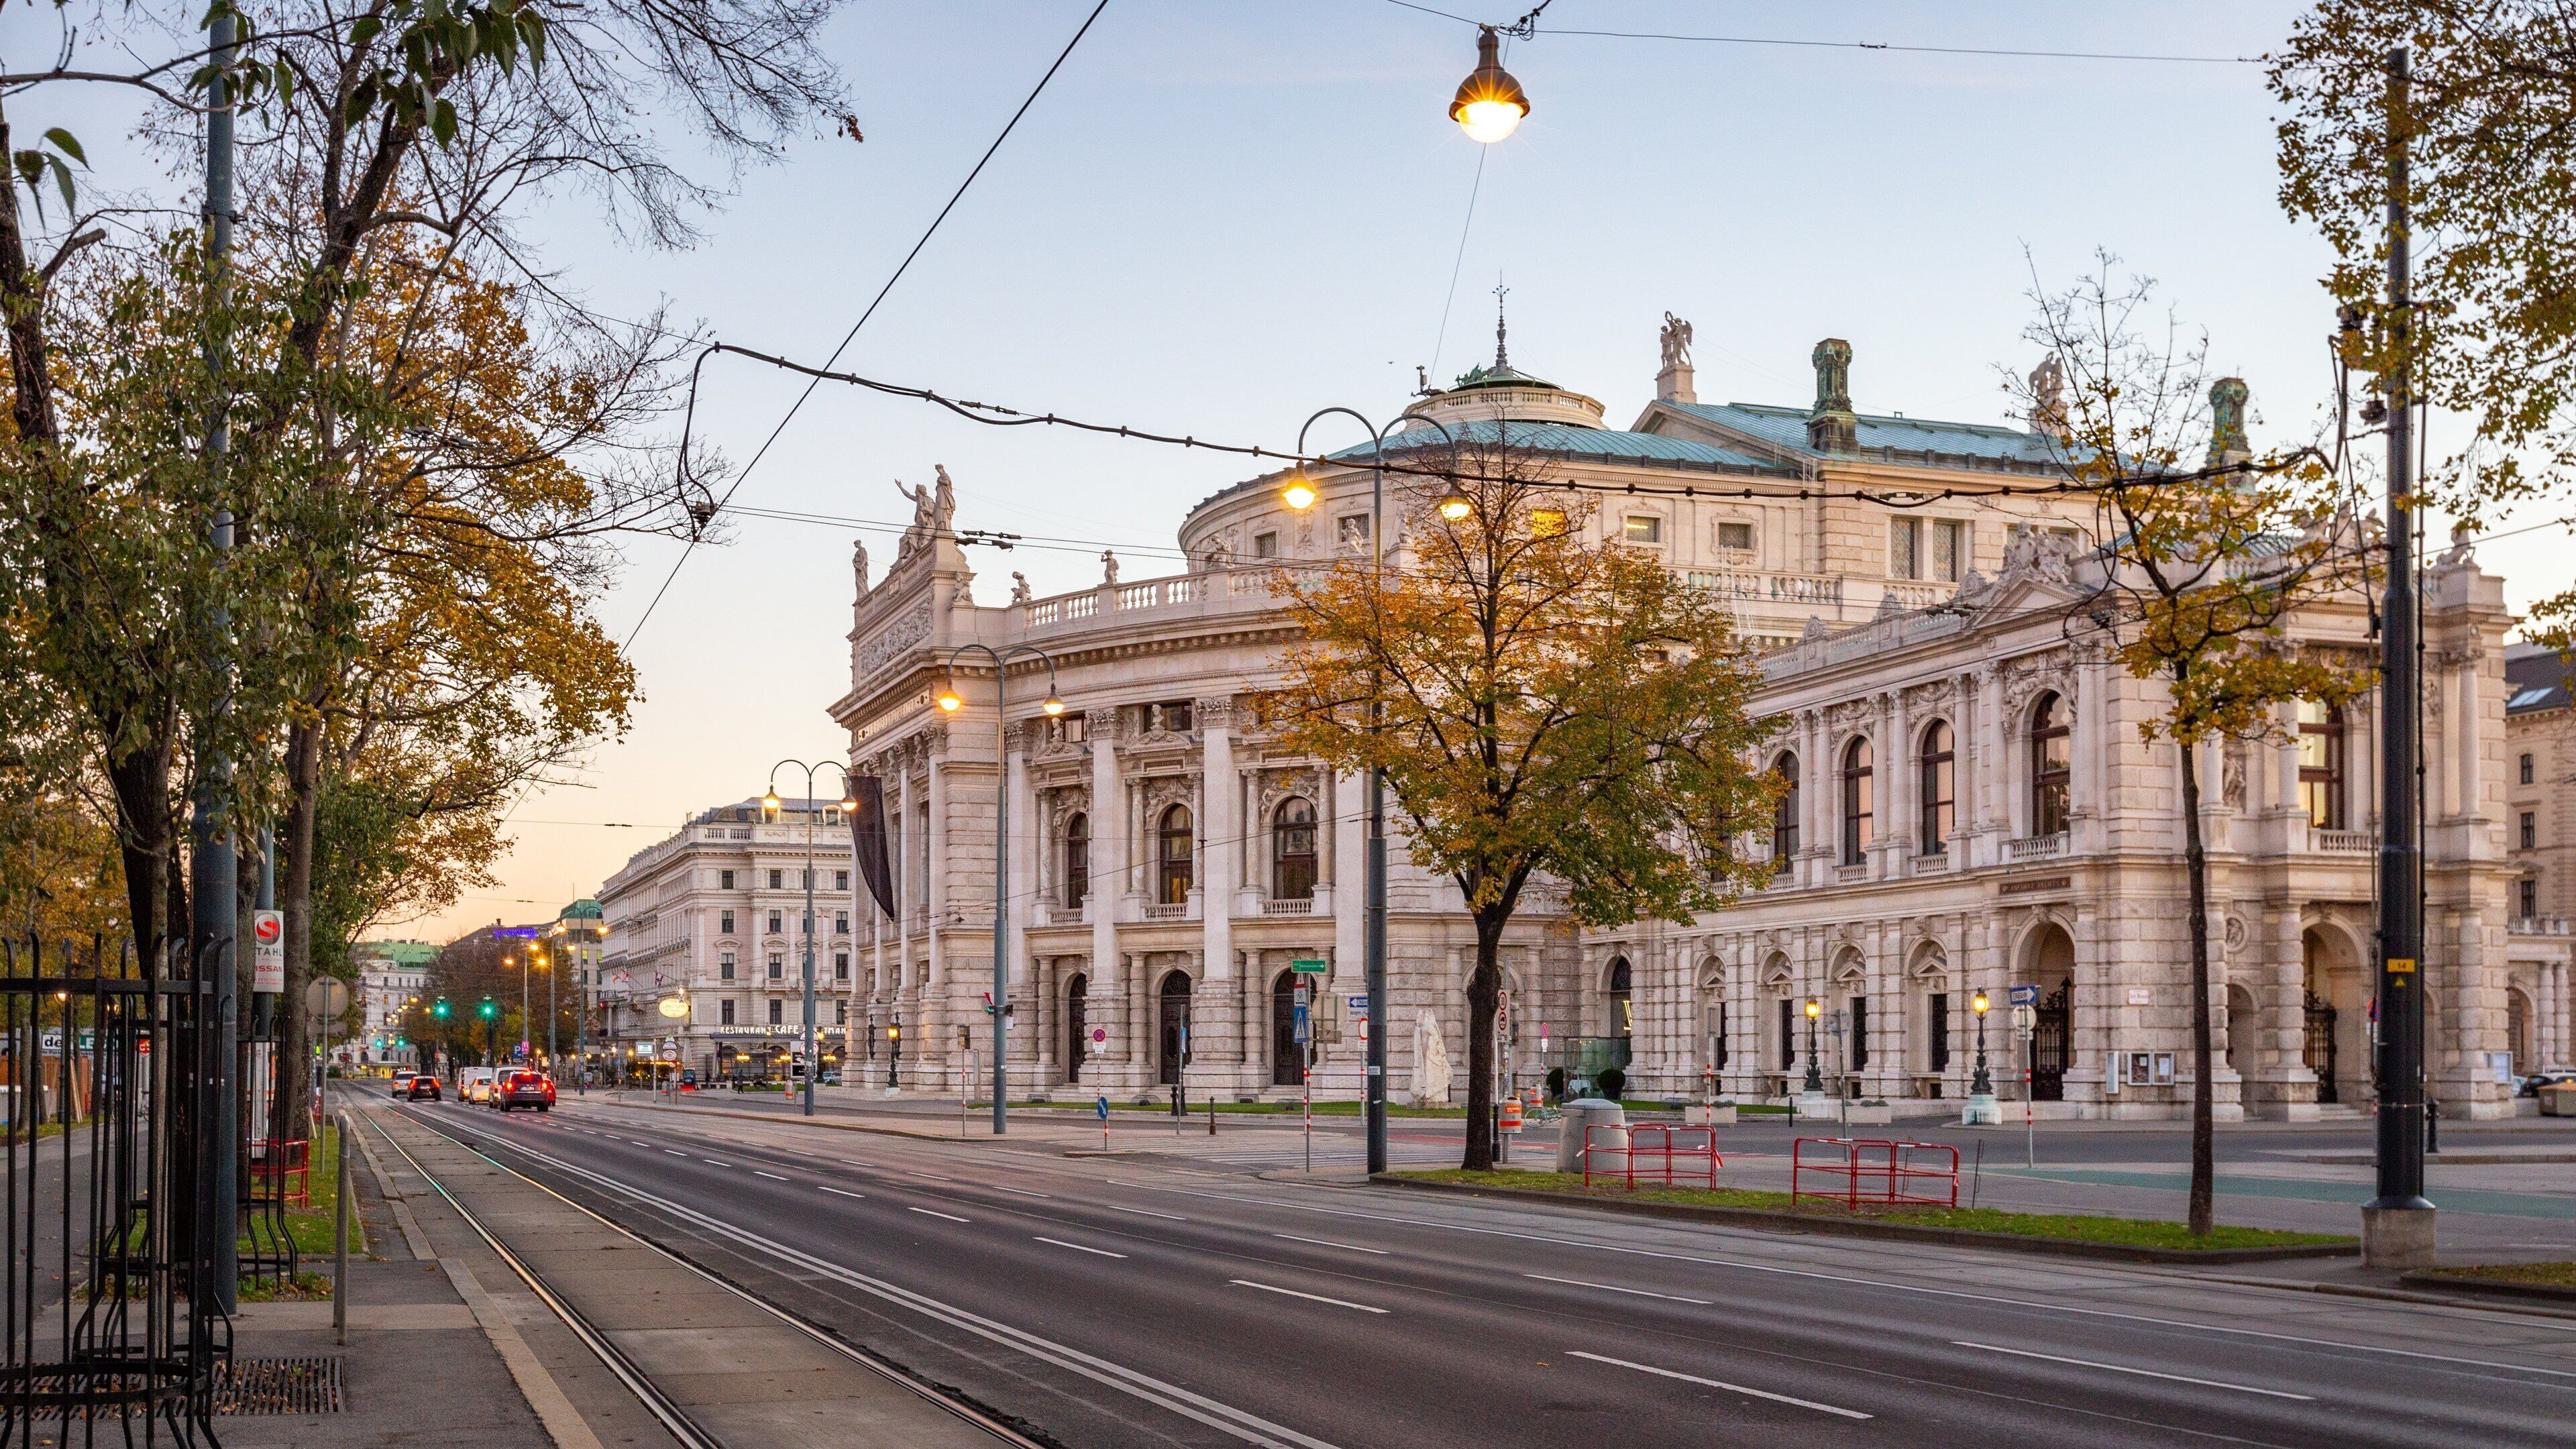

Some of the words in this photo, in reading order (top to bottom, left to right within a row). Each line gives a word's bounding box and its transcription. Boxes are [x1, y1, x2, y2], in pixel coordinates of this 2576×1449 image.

[255, 947, 282, 956] TAHL
[720, 1026, 771, 1034] RESTAURANT
[515, 1046, 521, 1055] P
